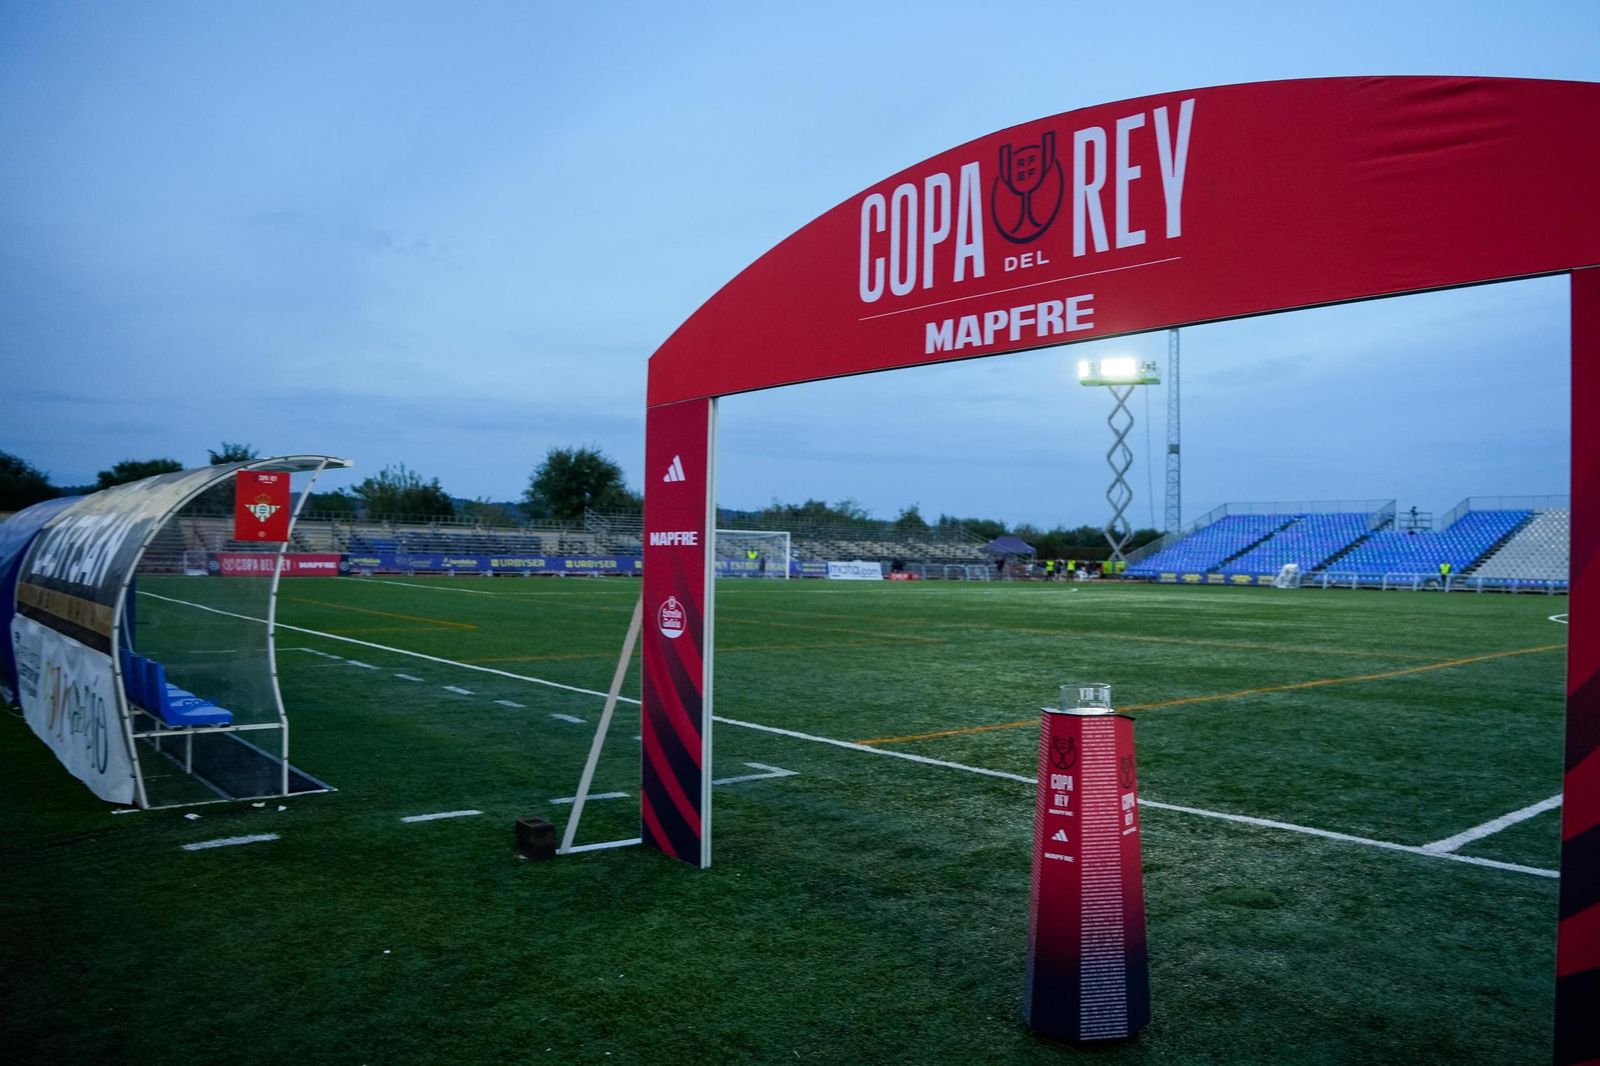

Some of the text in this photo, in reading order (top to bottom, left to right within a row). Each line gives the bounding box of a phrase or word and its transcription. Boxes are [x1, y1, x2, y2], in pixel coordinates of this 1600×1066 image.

[858, 98, 1196, 304] COPA REY
[1003, 250, 1050, 272] DEL
[925, 293, 1095, 355] MAPFRE
[649, 530, 699, 546] MAPFRE
[1051, 773, 1074, 791] COPA
